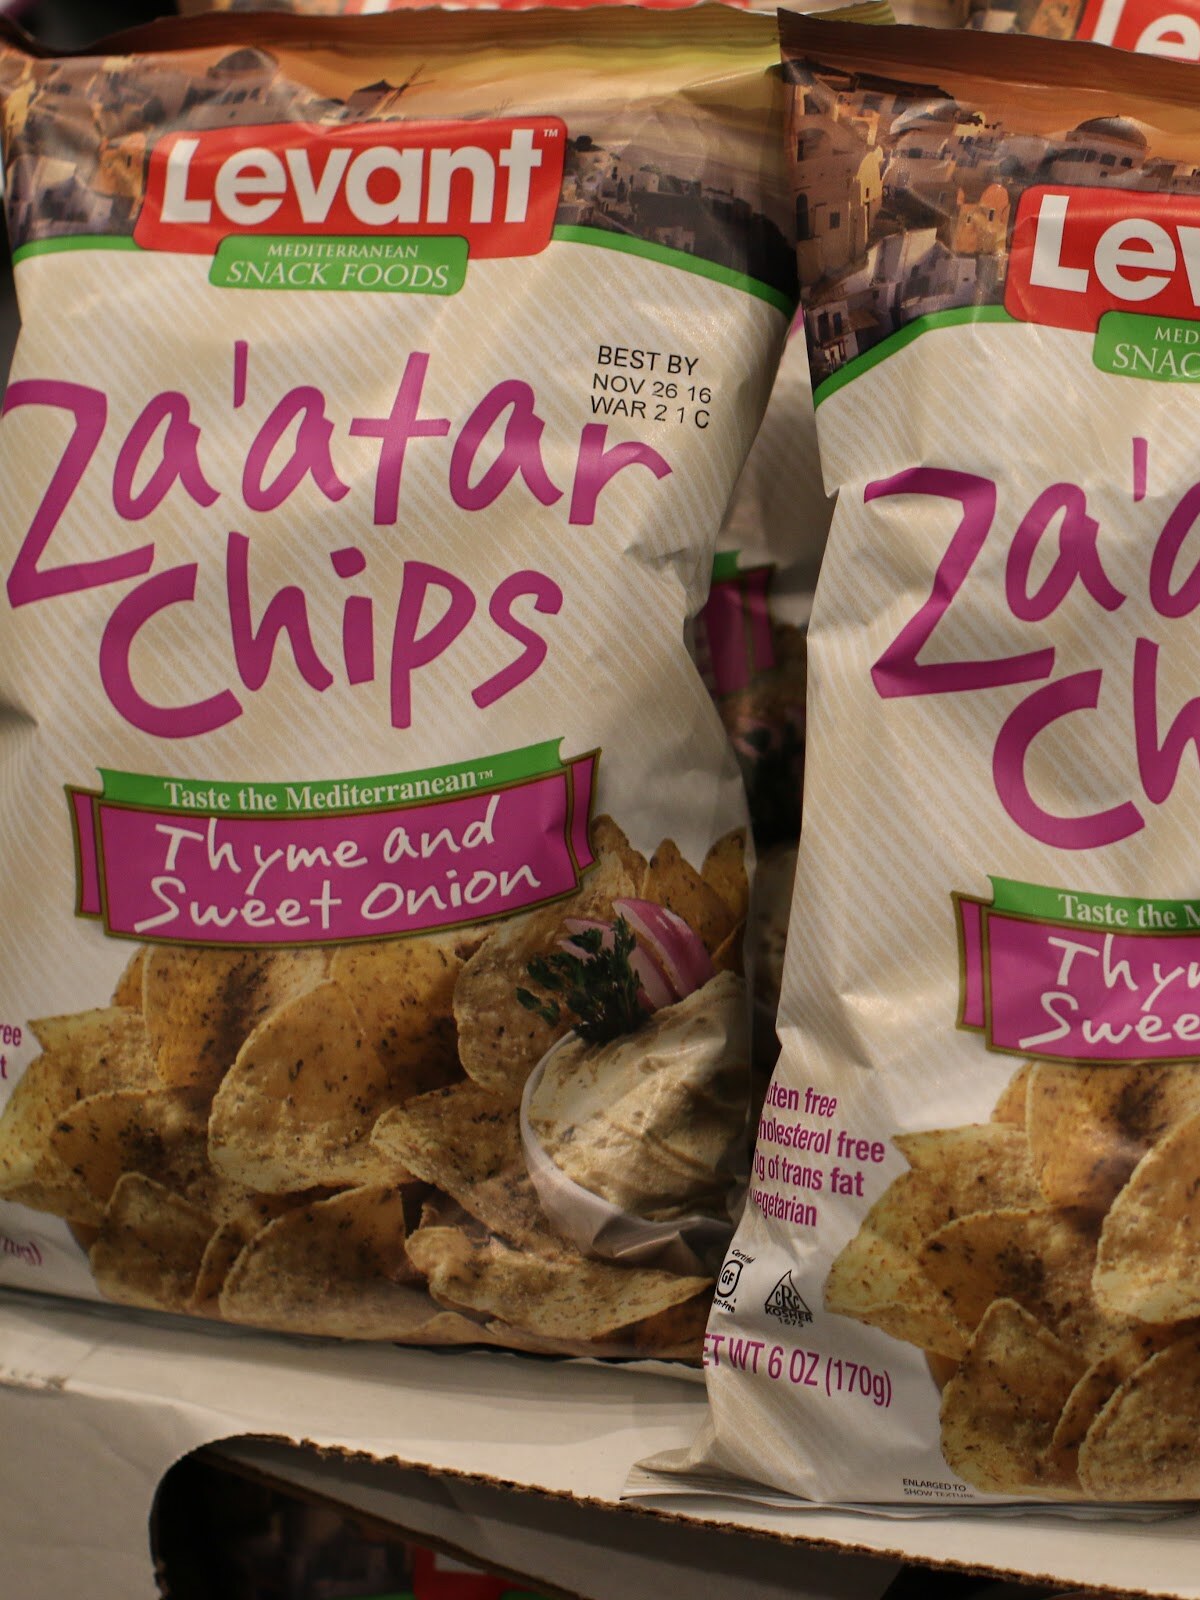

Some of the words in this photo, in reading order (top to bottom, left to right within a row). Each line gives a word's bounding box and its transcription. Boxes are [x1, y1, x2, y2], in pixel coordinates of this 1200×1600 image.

[159, 128, 542, 226] Levant
[268, 244, 419, 258] MEDITERRANEAN
[227, 261, 331, 285] SNACK
[340, 263, 449, 289] FOODS
[597, 345, 661, 371] BEST
[667, 354, 699, 376] BY
[593, 373, 645, 394] NOV
[652, 381, 678, 398] 26
[688, 386, 711, 404] 16
[591, 395, 646, 419] WAR
[0, 341, 673, 608] Za'atar
[100, 532, 563, 739] Chips
[164, 782, 231, 808] Taste
[238, 787, 277, 810] the
[155, 817, 367, 896] Thyme
[383, 795, 500, 864] and
[134, 876, 342, 934] Sweet
[1058, 893, 1129, 927] Taste
[1137, 903, 1177, 928] the
[805, 1087, 837, 1118] free
[760, 1114, 832, 1154] holesterol
[837, 1130, 886, 1163] free
[768, 1154, 779, 1180] of
[782, 1157, 823, 1190] trans
[830, 1167, 864, 1197] fat
[764, 1304, 814, 1323] KOSHER
[729, 1337, 765, 1374] WT
[768, 1346, 784, 1379] 6
[789, 1349, 820, 1386] OZ
[826, 1357, 892, 1407] (170g)
[902, 1478, 951, 1490] ENLARGED
[953, 1484, 967, 1492] TO
[903, 1488, 933, 1497] SHOW
